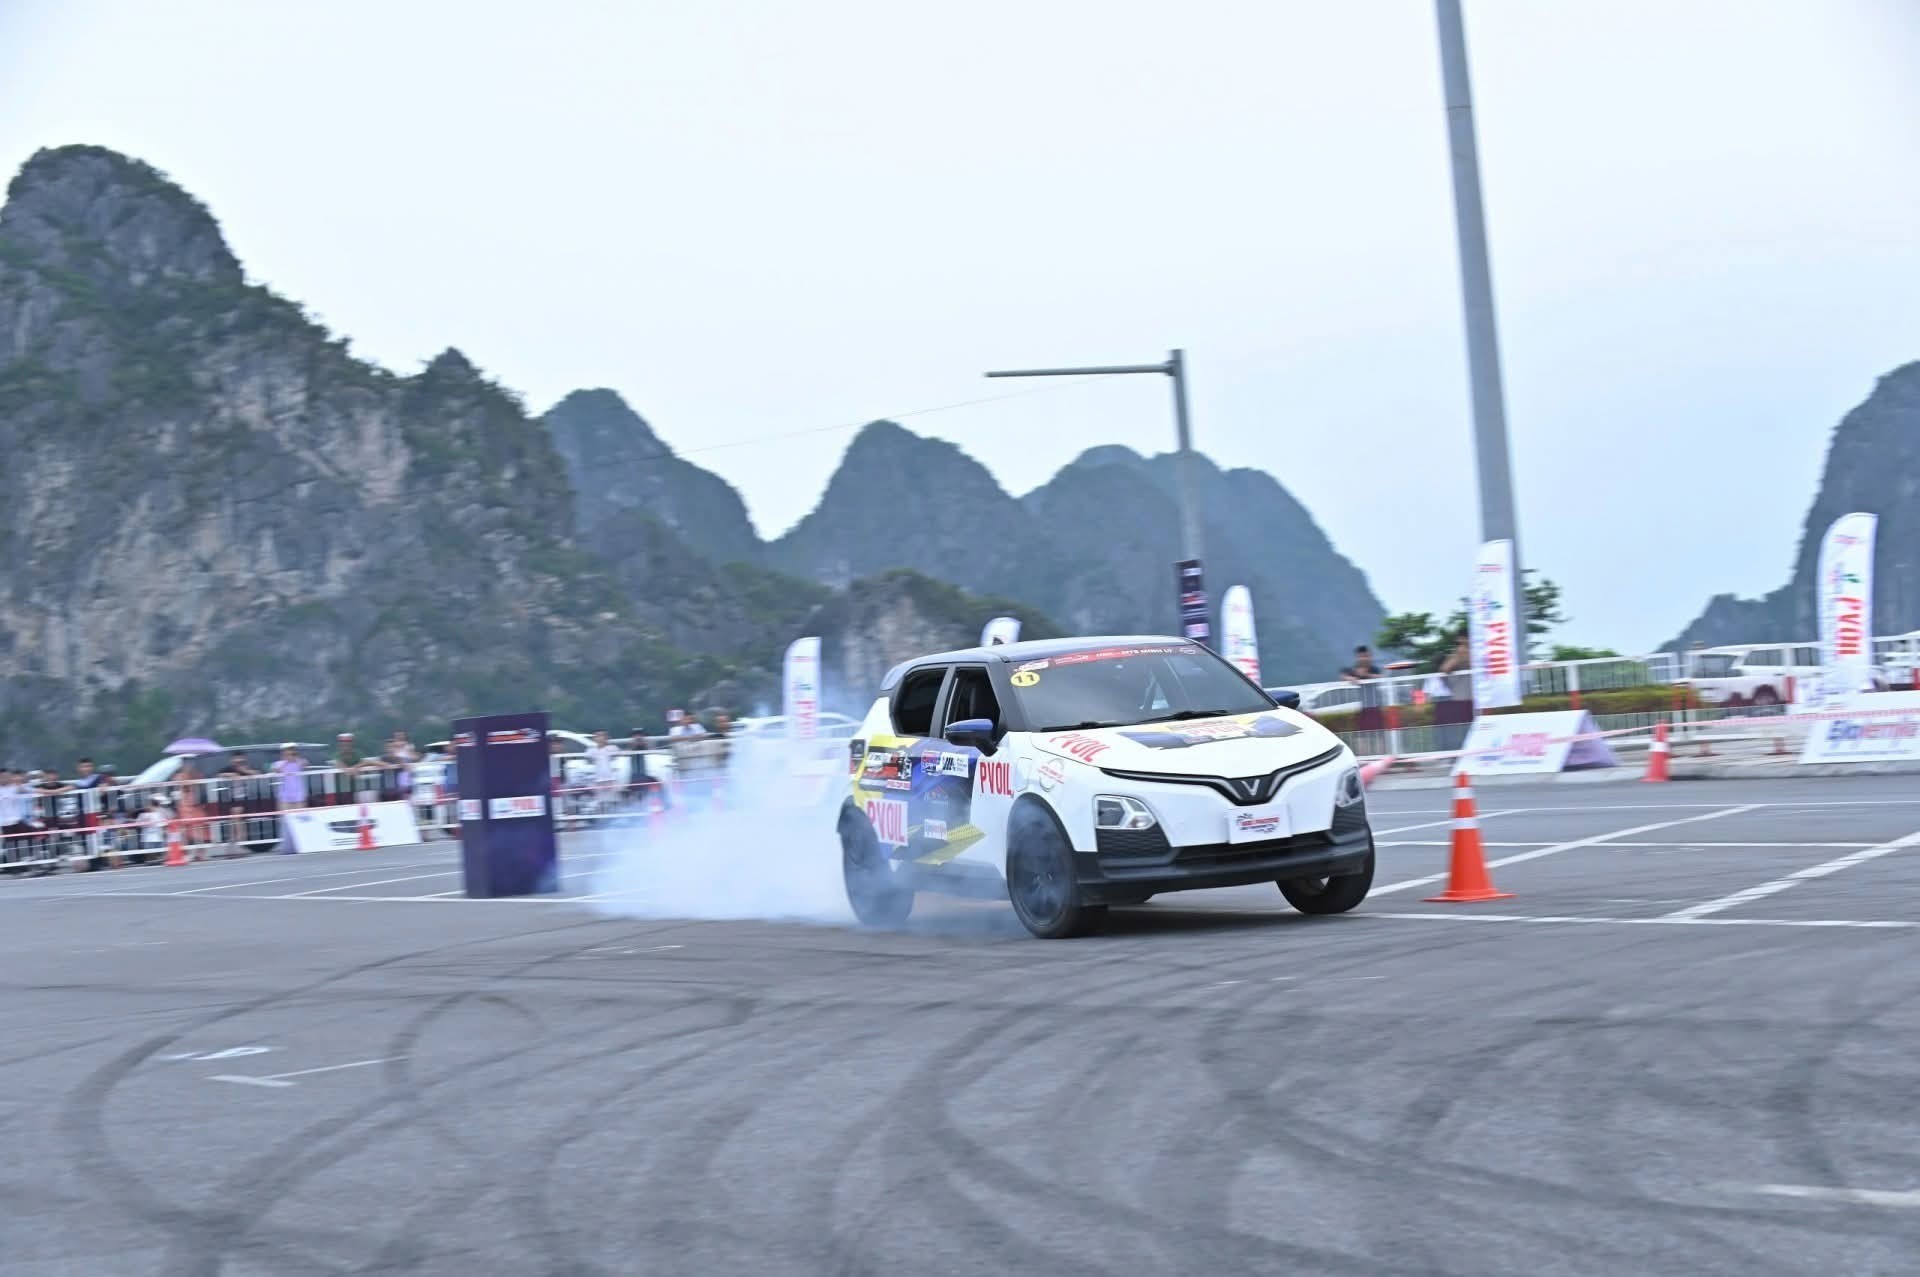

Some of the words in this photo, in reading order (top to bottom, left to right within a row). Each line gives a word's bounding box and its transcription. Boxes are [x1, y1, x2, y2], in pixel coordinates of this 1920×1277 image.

[1048, 733, 1110, 763] PVOIL
[979, 762, 1012, 795] PVOIL
[866, 800, 905, 843] PVOIL
